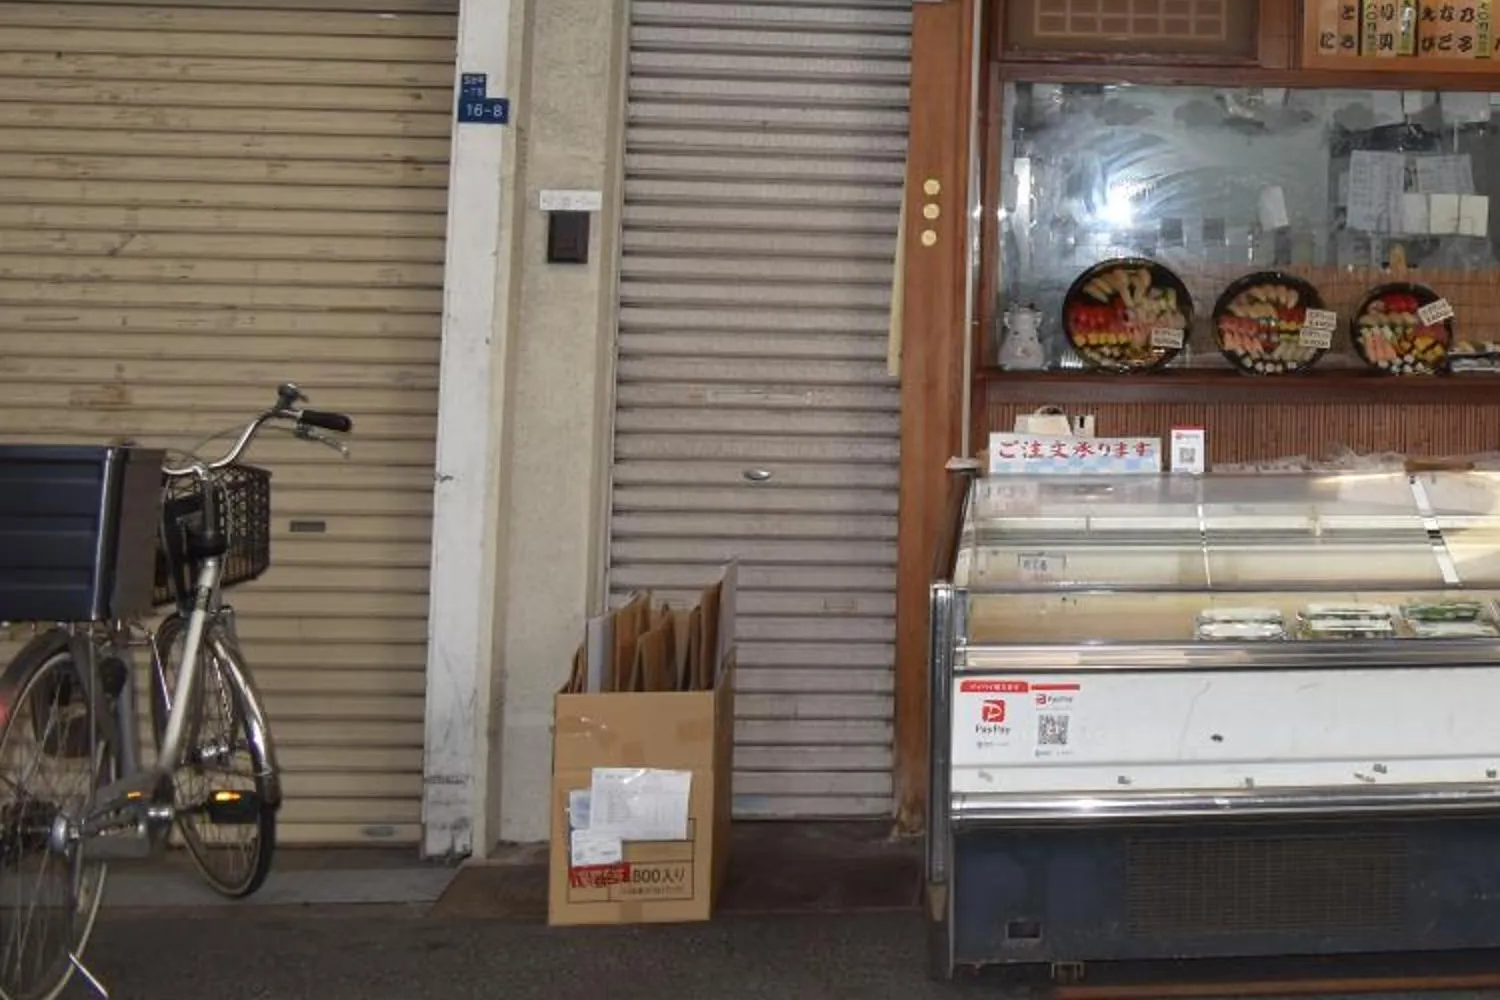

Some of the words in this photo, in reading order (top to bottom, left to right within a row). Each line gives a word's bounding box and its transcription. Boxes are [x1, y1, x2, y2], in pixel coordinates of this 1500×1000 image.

[999, 440, 1153, 460] ご注文承ります
